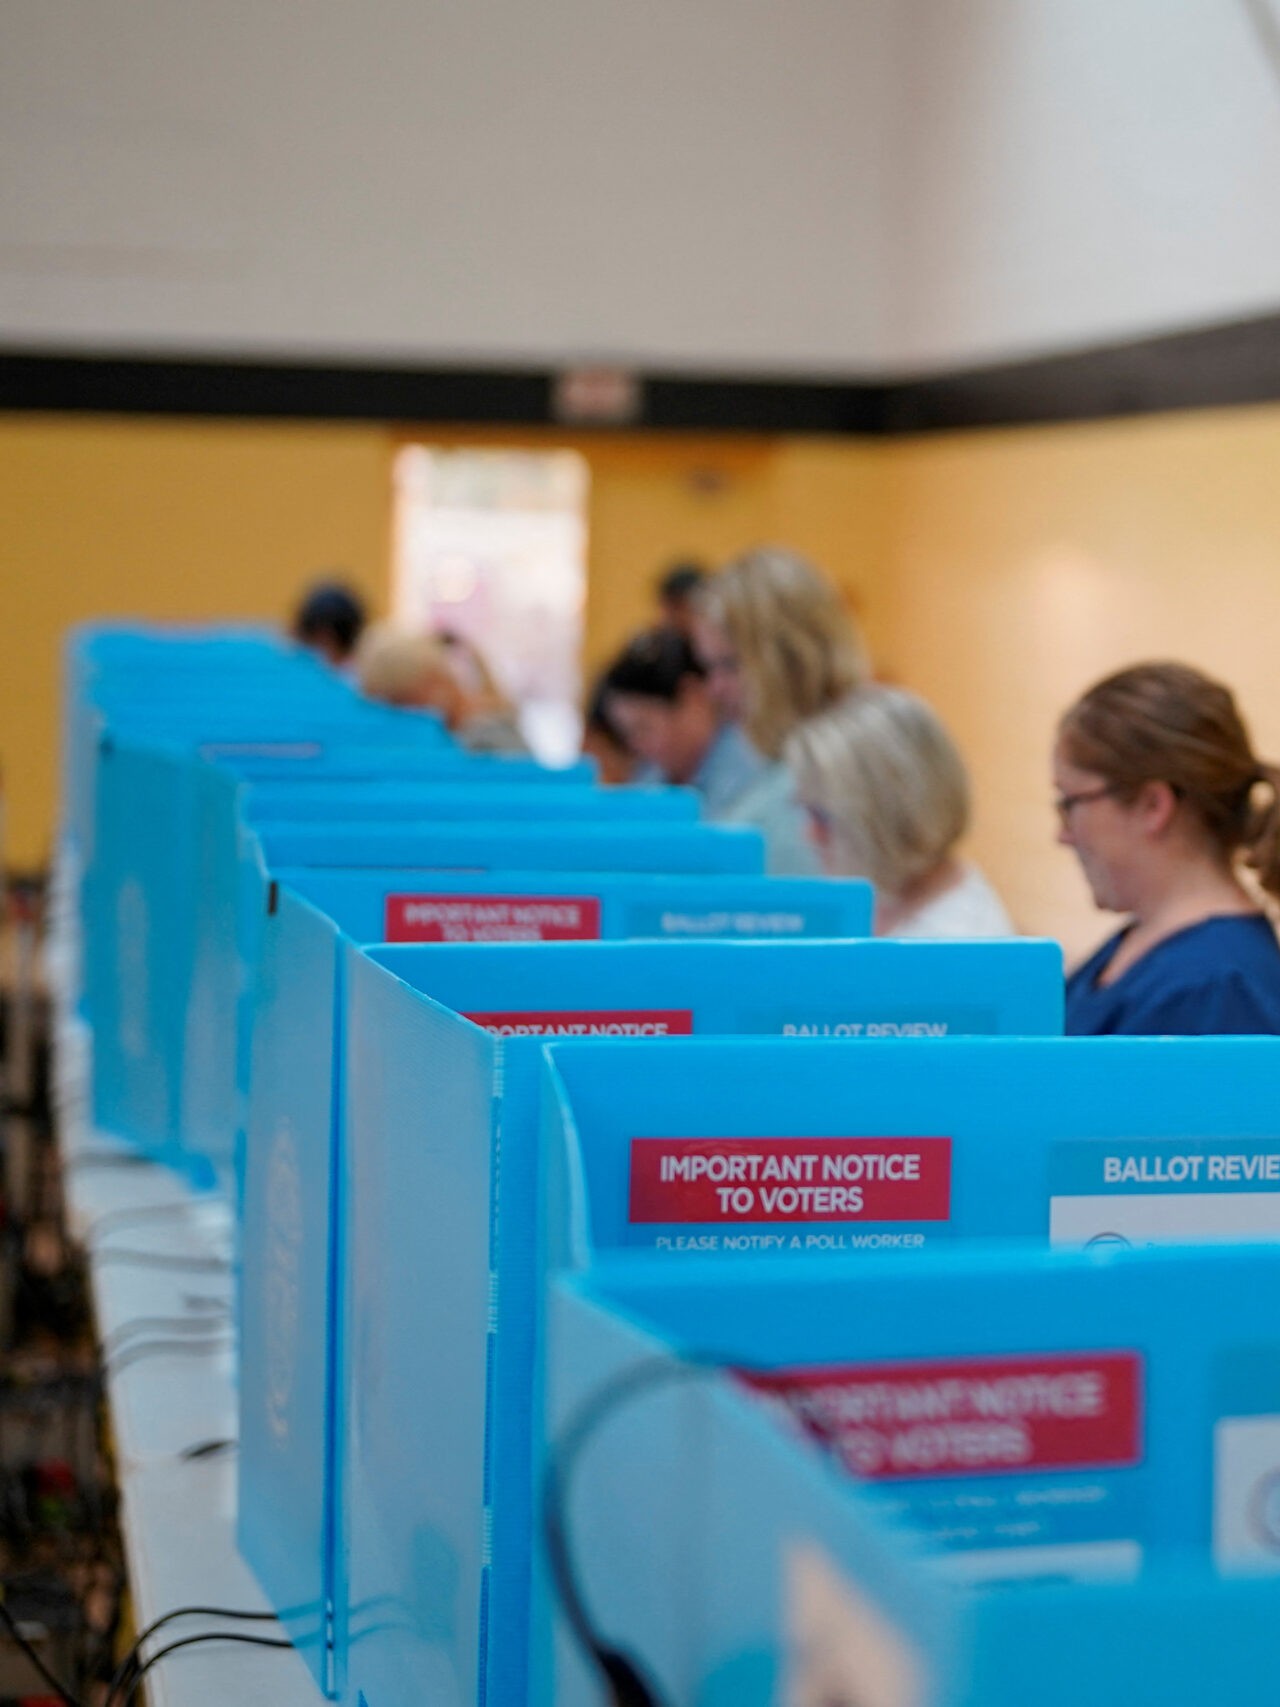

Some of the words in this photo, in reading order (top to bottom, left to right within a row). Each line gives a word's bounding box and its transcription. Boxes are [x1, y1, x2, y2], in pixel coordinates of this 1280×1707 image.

[590, 1023, 668, 1036] NOTICE
[660, 1155, 818, 1181] IMPORTANT
[822, 1154, 921, 1180] NOTICE
[1103, 1156, 1203, 1182] BALLOT
[716, 1187, 754, 1213] TO
[759, 1186, 864, 1213] VOTERS
[656, 1236, 719, 1251] PLEASE
[723, 1235, 785, 1250] NOTIFY
[789, 1235, 801, 1249] A
[805, 1234, 847, 1249] POLL
[852, 1234, 925, 1249] WORKER
